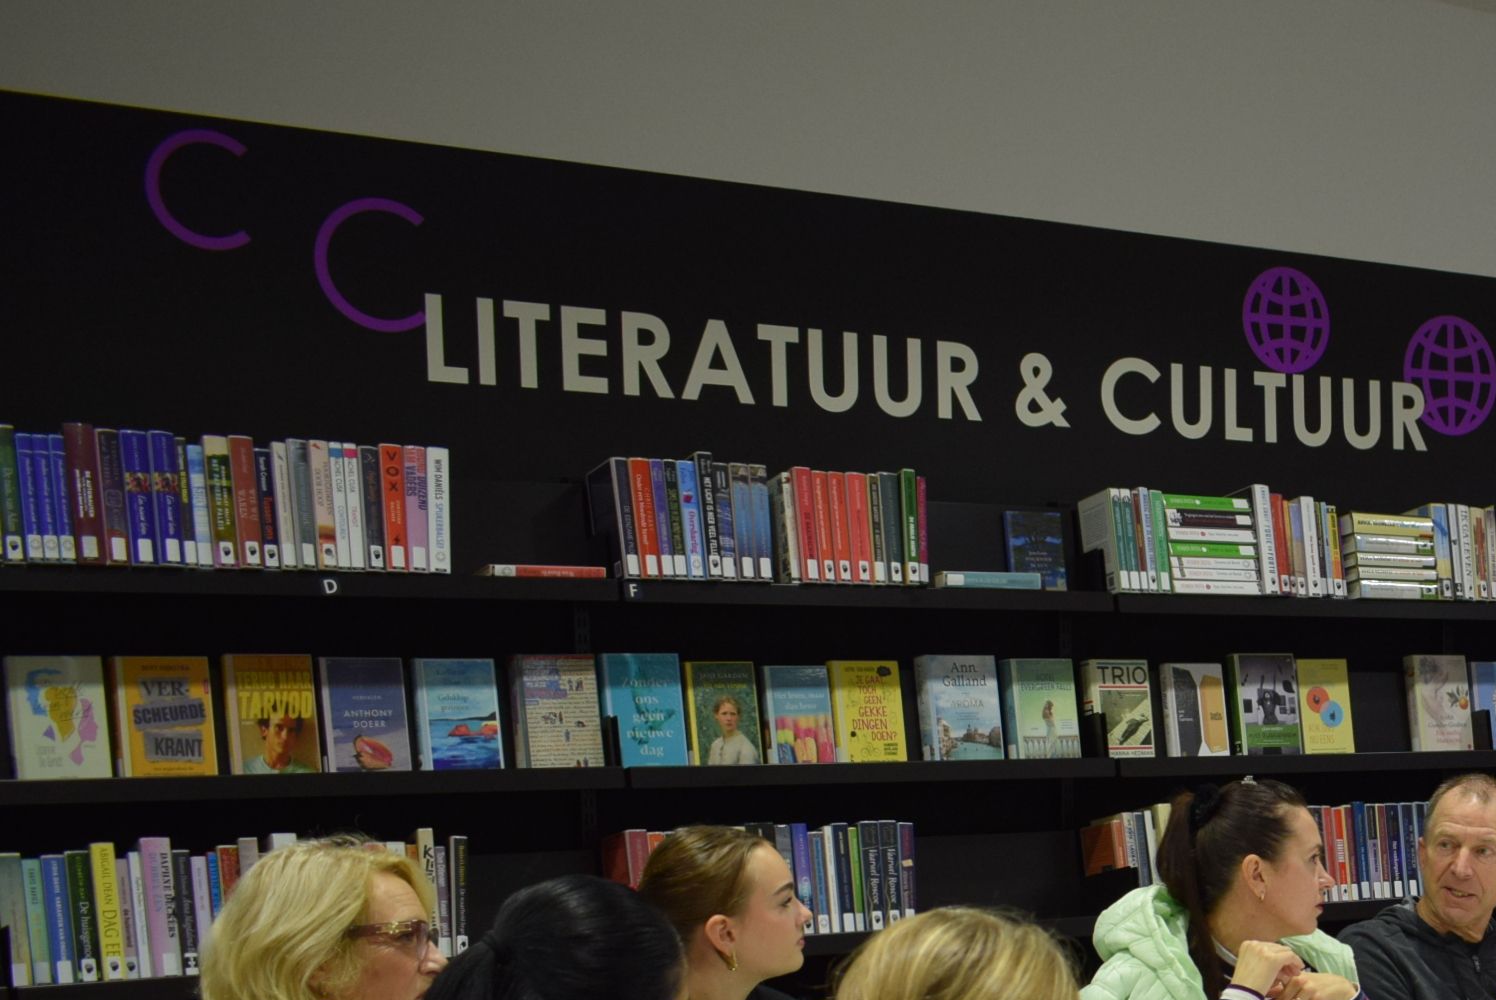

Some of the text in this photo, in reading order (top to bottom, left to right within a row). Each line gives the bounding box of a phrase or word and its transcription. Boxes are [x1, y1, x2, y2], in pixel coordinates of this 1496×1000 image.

[426, 294, 1429, 452] LITERATUUR & CULTUUR
[434, 459, 442, 473] WIM
[406, 467, 417, 496] VADERS
[703, 477, 712, 487] HET
[418, 476, 428, 511] DUIZEND
[704, 488, 713, 504] LICHT
[707, 512, 716, 524] HIER
[708, 526, 717, 539] VEEL
[1464, 542, 1472, 577] LEVEN
[323, 579, 338, 594] D
[629, 583, 638, 598] F
[950, 662, 977, 674] Ann
[237, 671, 313, 691] TERUG NAAR
[942, 674, 987, 687] Galland
[1096, 665, 1147, 685] TRIO
[141, 680, 191, 697] VER-
[622, 676, 674, 689] Zonder
[858, 685, 877, 695] TOCH
[238, 690, 314, 720] TARVOD
[635, 695, 659, 705] ons
[863, 696, 883, 704] GEEN
[133, 702, 206, 725] SCHEURDE
[343, 709, 394, 718] ANTHONY
[632, 712, 665, 723] geen
[858, 707, 888, 718] GEKKE
[352, 719, 388, 729] DOERR
[852, 720, 888, 731] DINGEN
[626, 728, 673, 739] nieuwe
[871, 733, 897, 742] DOEN?
[154, 737, 204, 758] KRANT
[640, 744, 664, 757] dag
[160, 853, 172, 890] DAPHNE
[871, 879, 880, 905] Roscoe
[888, 878, 897, 903] Roscoe
[79, 902, 89, 914] De
[98, 848, 121, 957] ABIGAIL DEAN DAG EE
